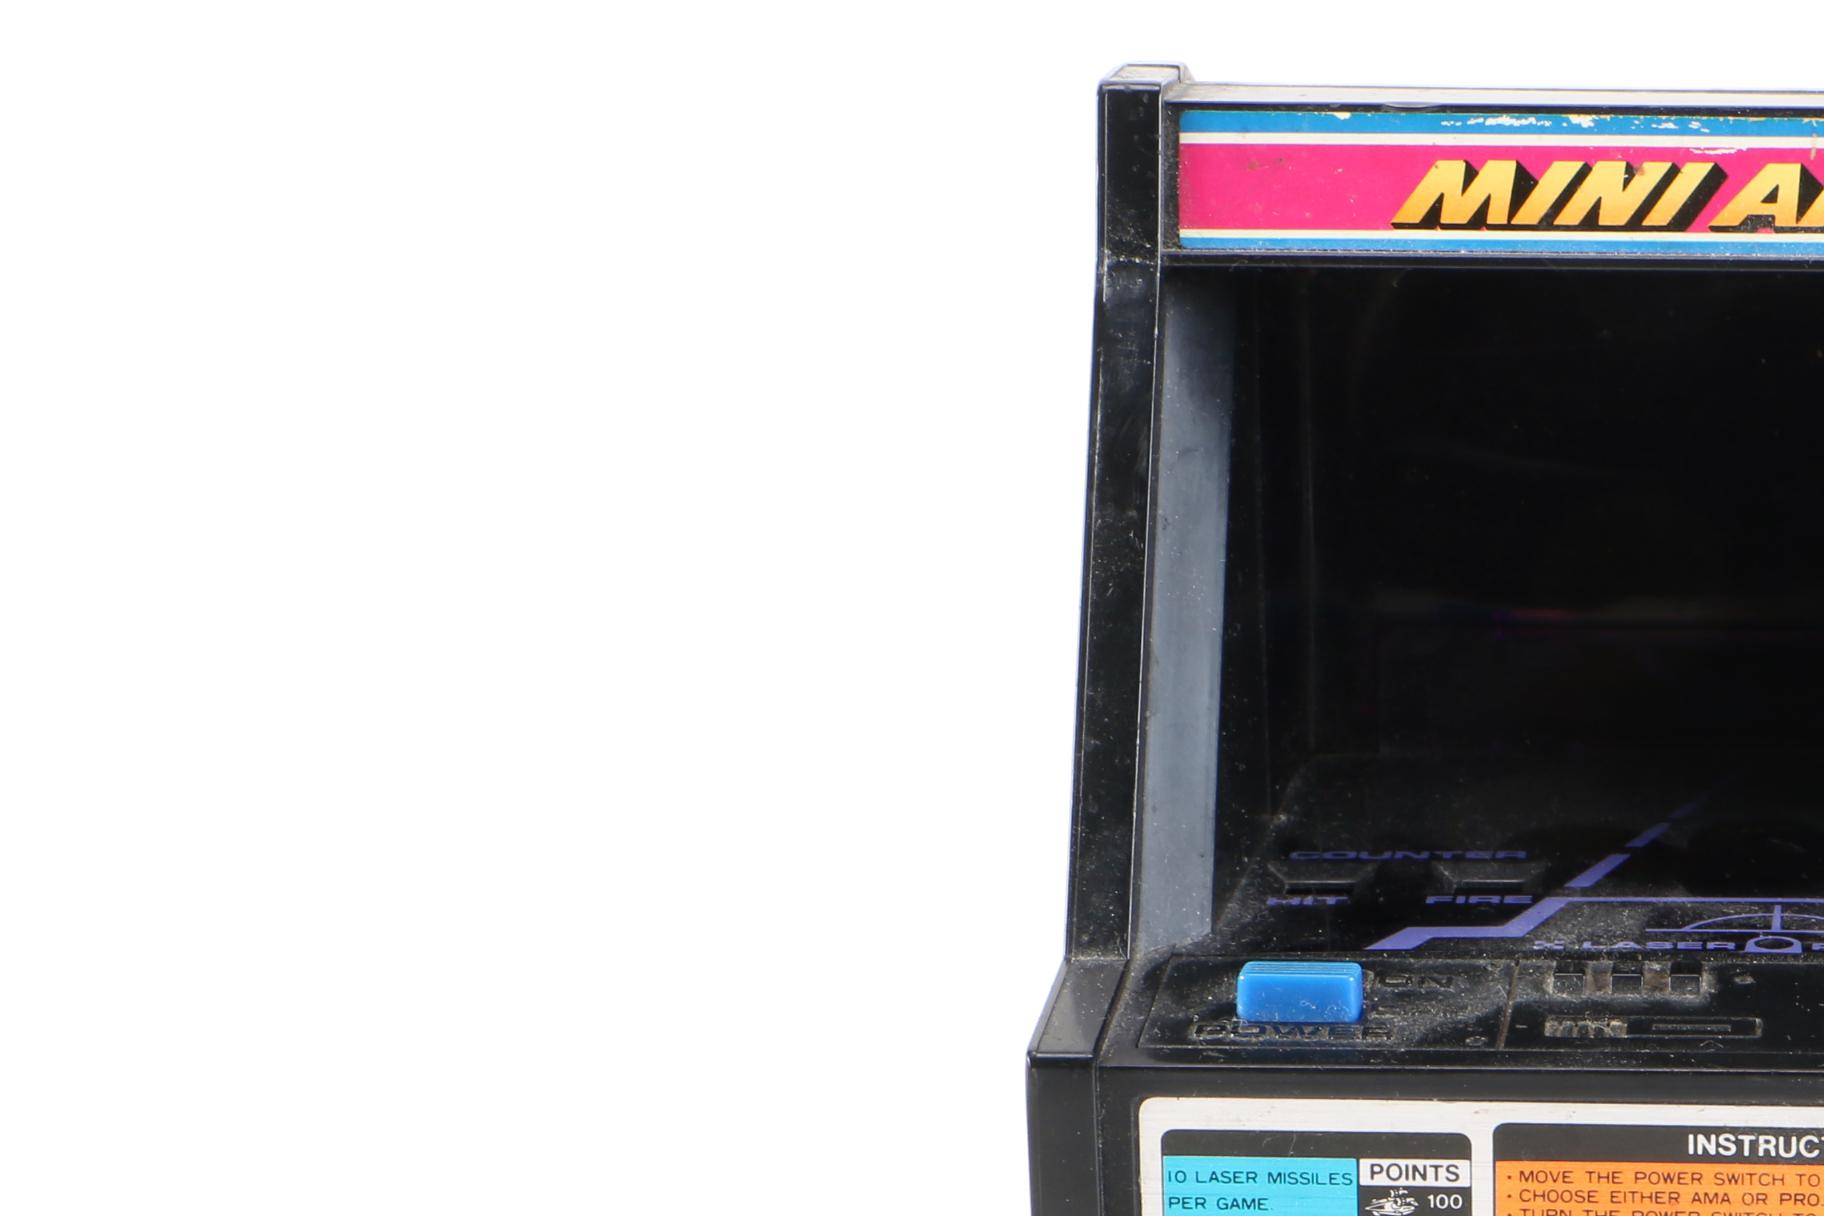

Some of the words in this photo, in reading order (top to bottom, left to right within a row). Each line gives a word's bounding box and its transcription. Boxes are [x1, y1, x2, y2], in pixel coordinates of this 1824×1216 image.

[1390, 160, 1728, 233] MINI
[1289, 851, 1527, 860] COUNTER
[1425, 896, 1532, 904] FIRE
[1583, 940, 1736, 952] LASER
[1196, 1171, 1257, 1184] LASER
[1267, 1172, 1352, 1185] MISSILES
[1370, 1164, 1460, 1182] POINTS
[1519, 1171, 1574, 1184] MOVE
[1586, 1171, 1623, 1184] THE
[1635, 1172, 1703, 1185] POWER
[1714, 1173, 1784, 1186] SWITCH
[1796, 1174, 1820, 1187] TO
[1169, 1197, 1207, 1210] PER
[1427, 1195, 1463, 1210] 100
[1519, 1189, 1598, 1203] CHOOSE
[1610, 1191, 1680, 1205] EITHER
[1691, 1193, 1731, 1205] AMA
[1741, 1193, 1768, 1206] OR
[1779, 1193, 1824, 1207] PRO.
